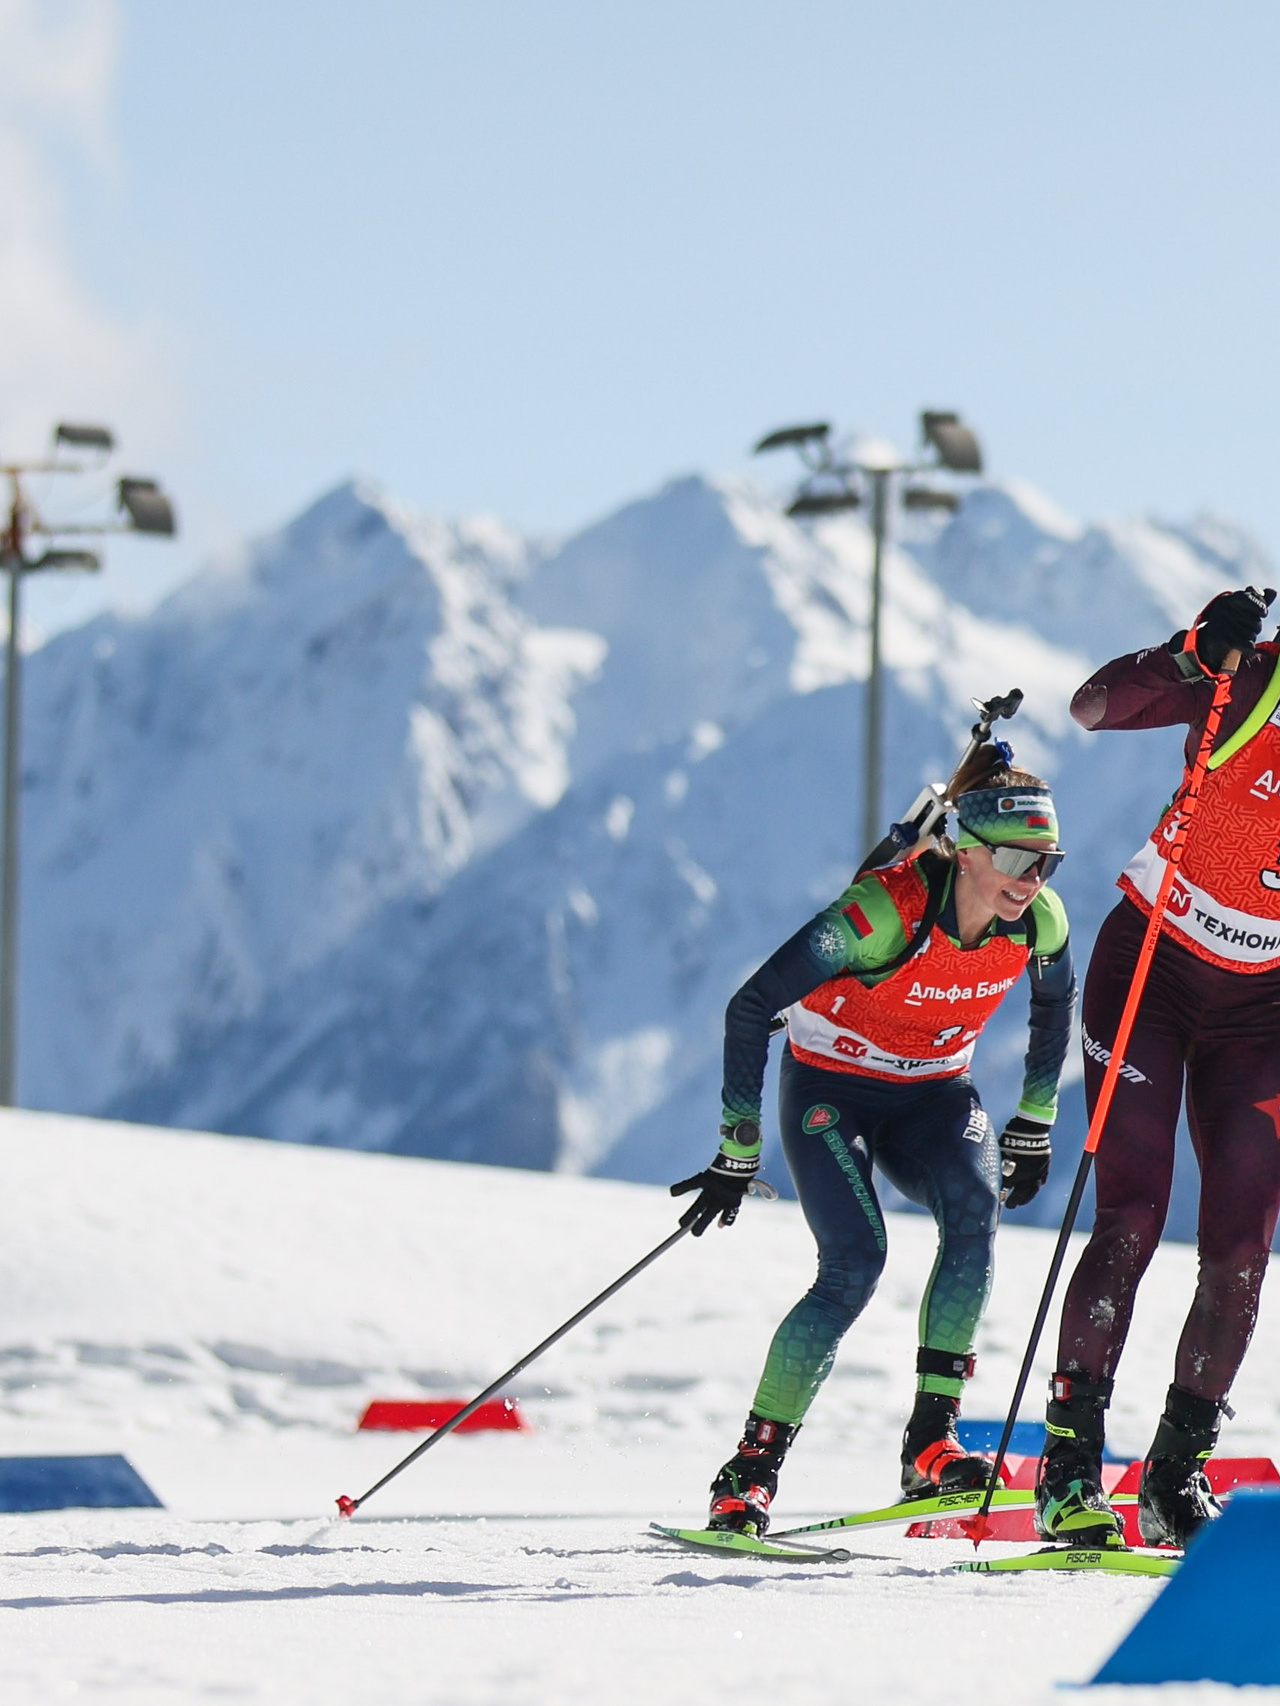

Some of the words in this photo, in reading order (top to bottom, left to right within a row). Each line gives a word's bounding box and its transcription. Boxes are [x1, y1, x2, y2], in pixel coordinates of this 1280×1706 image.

[904, 981, 973, 1006] Альфа
[976, 976, 1017, 998] Банк
[831, 995, 846, 1015] 1
[822, 1128, 887, 1252] БЕЛОРУСНЕФТЬ
[937, 1493, 981, 1508] FISCHER
[1066, 1552, 1102, 1564] FISCHER
